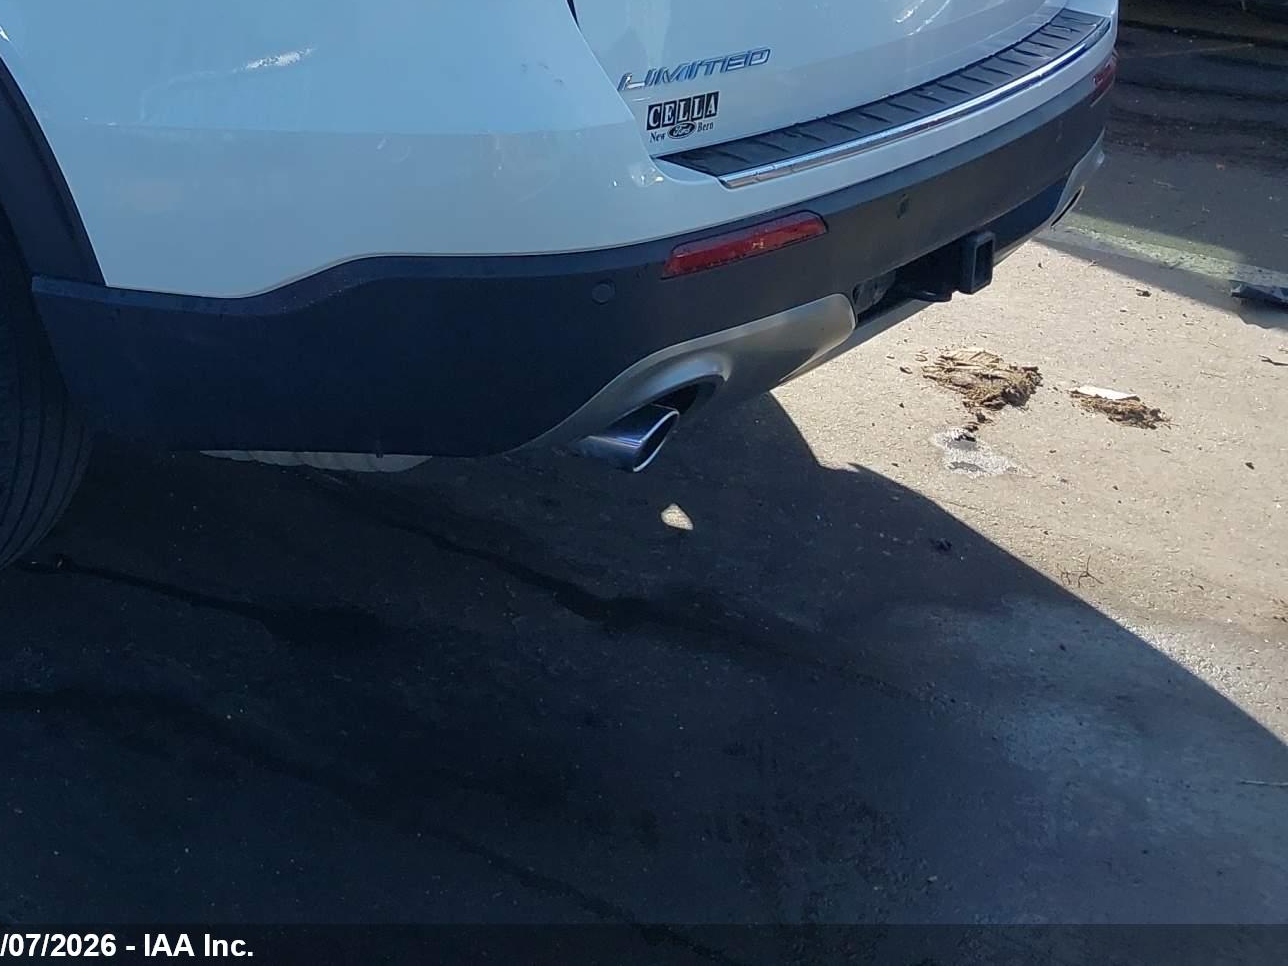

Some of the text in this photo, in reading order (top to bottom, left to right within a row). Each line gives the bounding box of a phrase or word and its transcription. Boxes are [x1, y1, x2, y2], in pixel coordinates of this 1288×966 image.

[617, 47, 772, 91] LIMITED
[647, 91, 719, 130] CELLA
[649, 120, 714, 143] New Ford Bern
